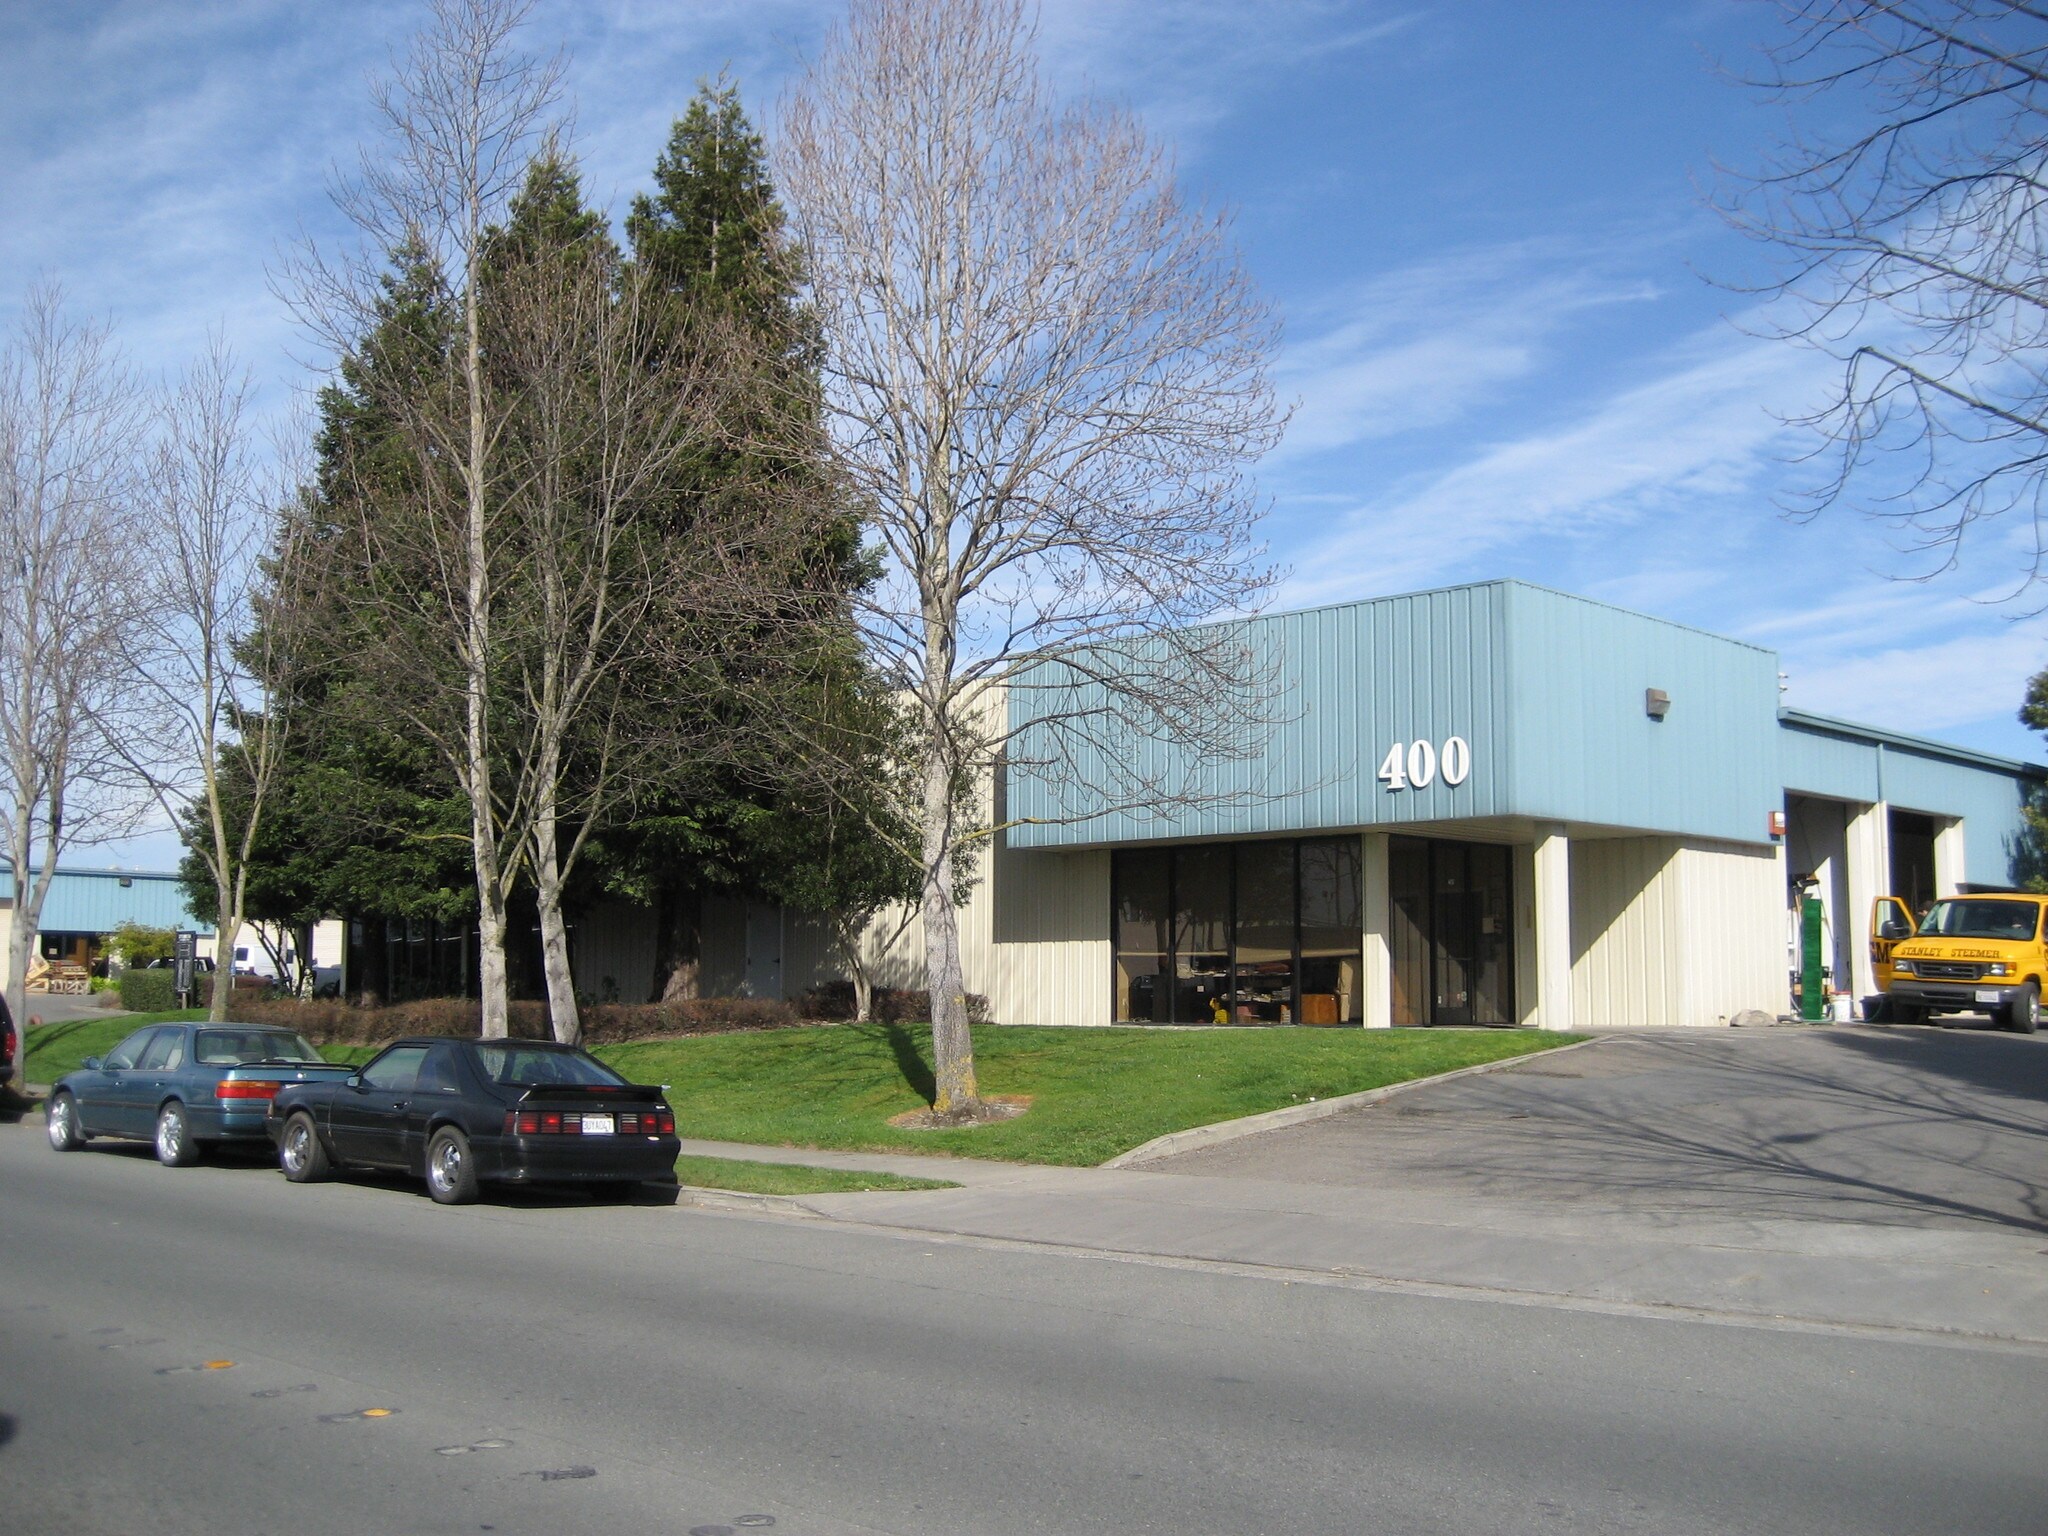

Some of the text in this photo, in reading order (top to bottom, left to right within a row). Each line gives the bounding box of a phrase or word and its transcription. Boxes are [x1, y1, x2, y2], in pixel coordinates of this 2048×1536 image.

[1378, 736, 1470, 789] 400
[1901, 946, 2000, 959] STANLEY STEEMER
